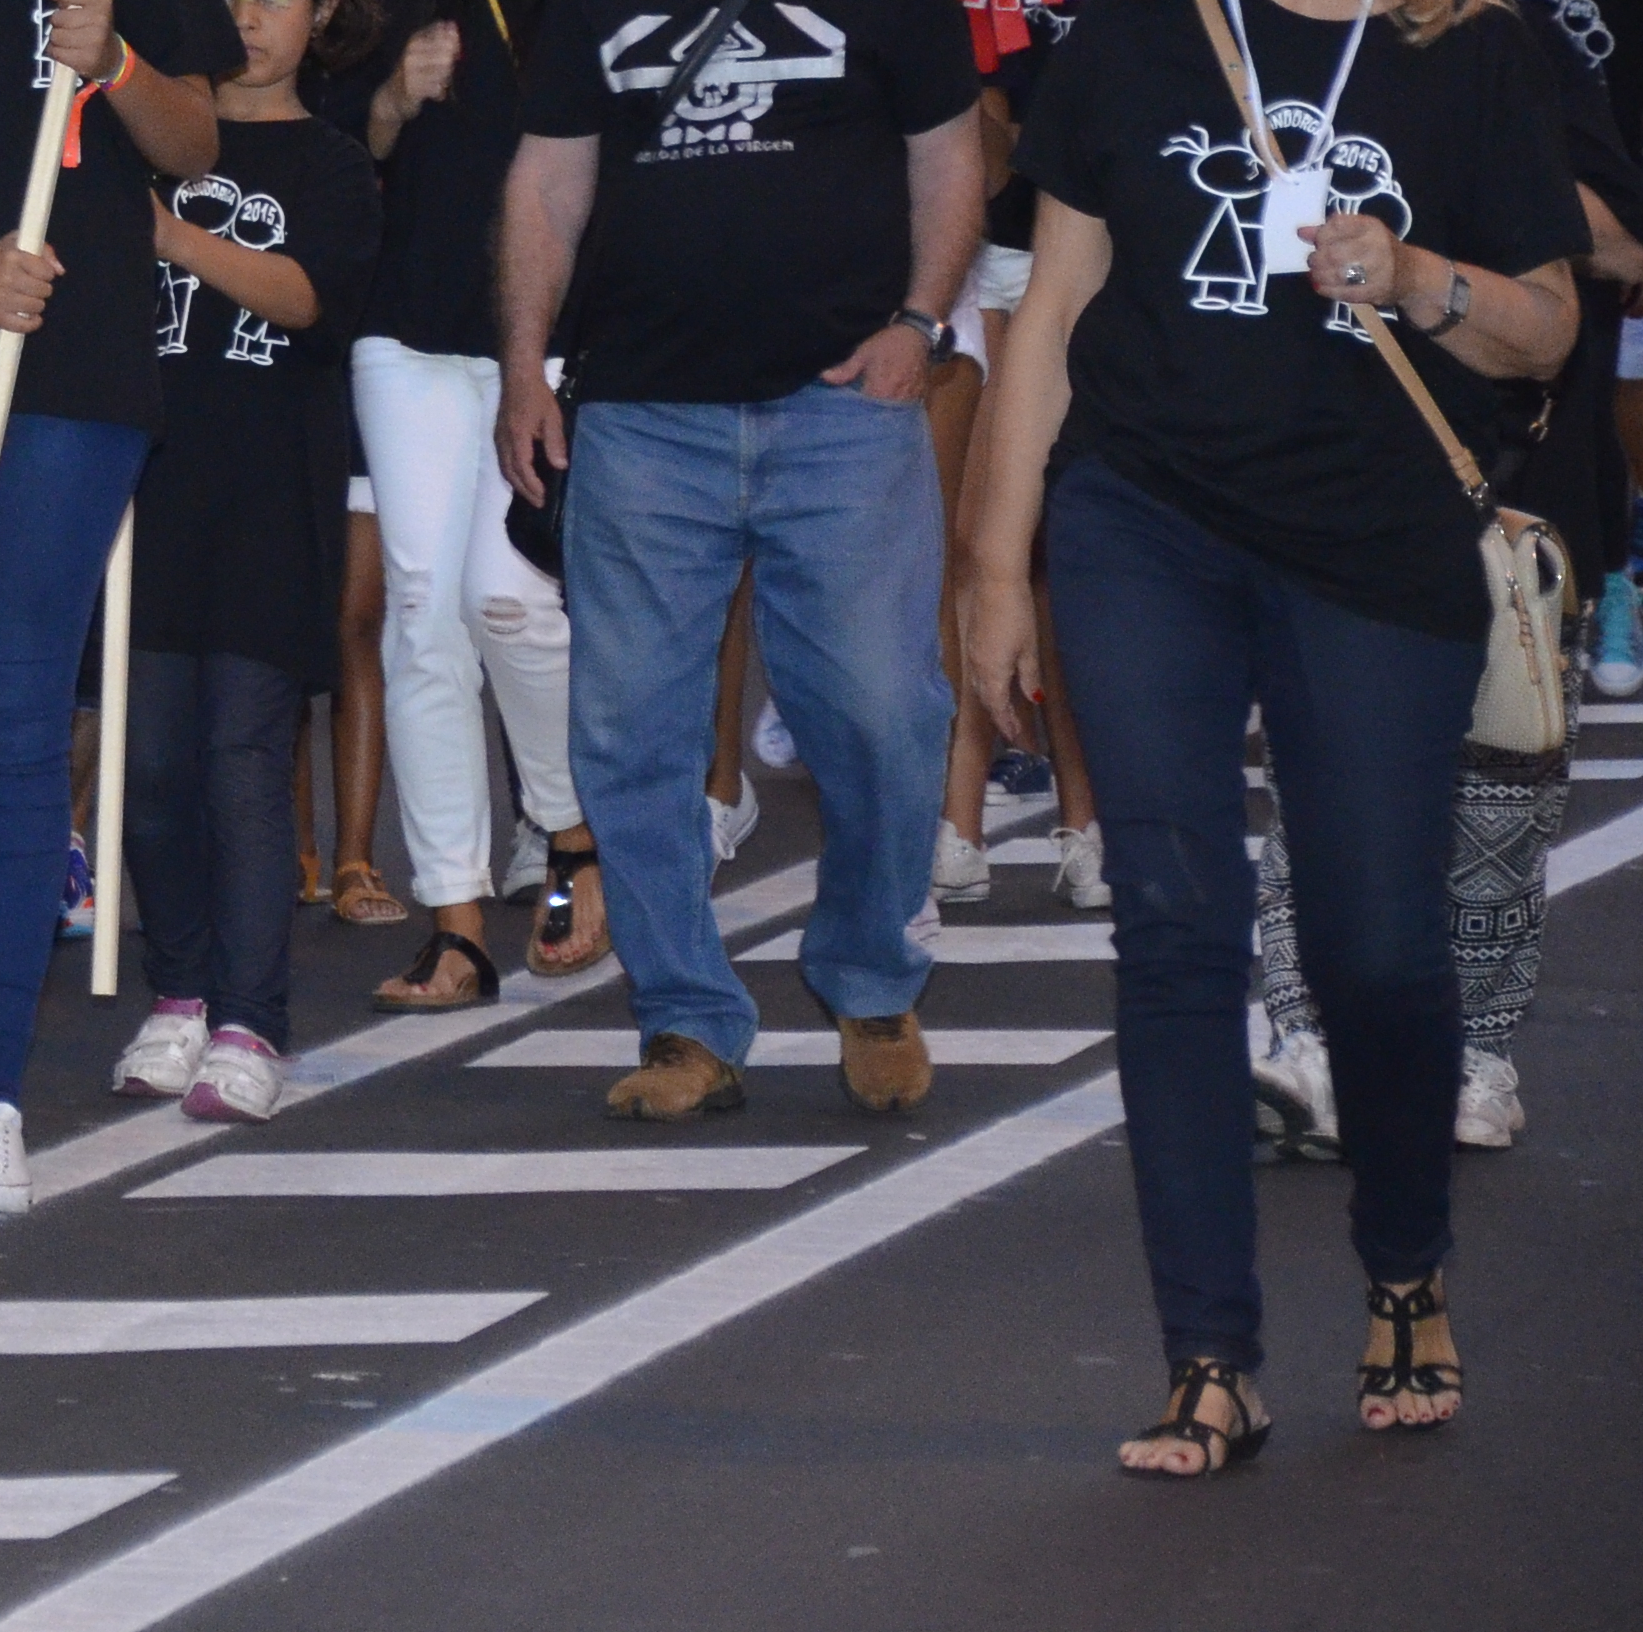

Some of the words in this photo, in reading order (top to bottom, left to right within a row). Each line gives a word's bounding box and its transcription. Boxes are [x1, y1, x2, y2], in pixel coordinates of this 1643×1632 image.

[734, 139, 795, 153] VIRGEN
[1331, 143, 1382, 173] 2015
[240, 200, 277, 226] 2015
